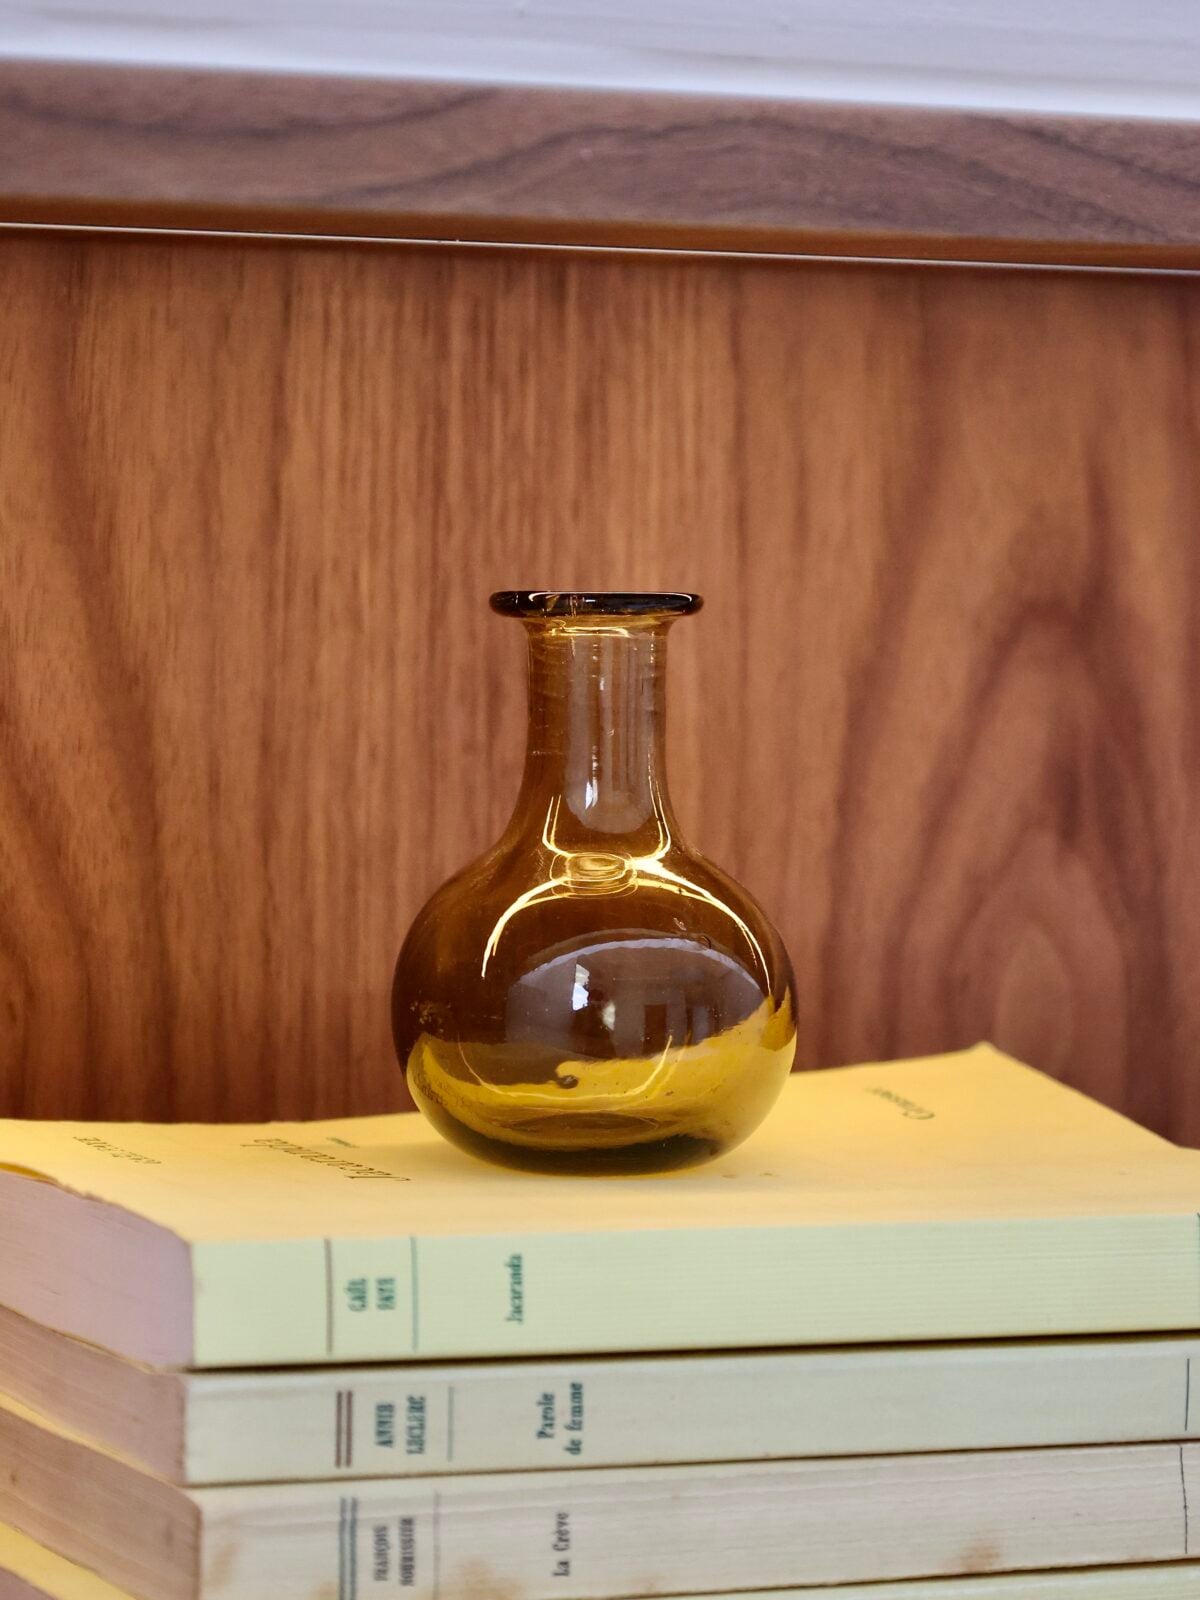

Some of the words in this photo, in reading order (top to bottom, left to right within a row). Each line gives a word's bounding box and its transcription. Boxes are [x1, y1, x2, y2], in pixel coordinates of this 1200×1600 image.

[505, 1253, 523, 1324] Jacaranda
[375, 1402, 395, 1448] ANNIE
[406, 1396, 426, 1455] LECLERC
[537, 1392, 555, 1439] Parole
[565, 1381, 583, 1431] femme
[564, 1438, 581, 1455] de
[553, 1512, 570, 1551] Crève
[554, 1560, 570, 1577] La
